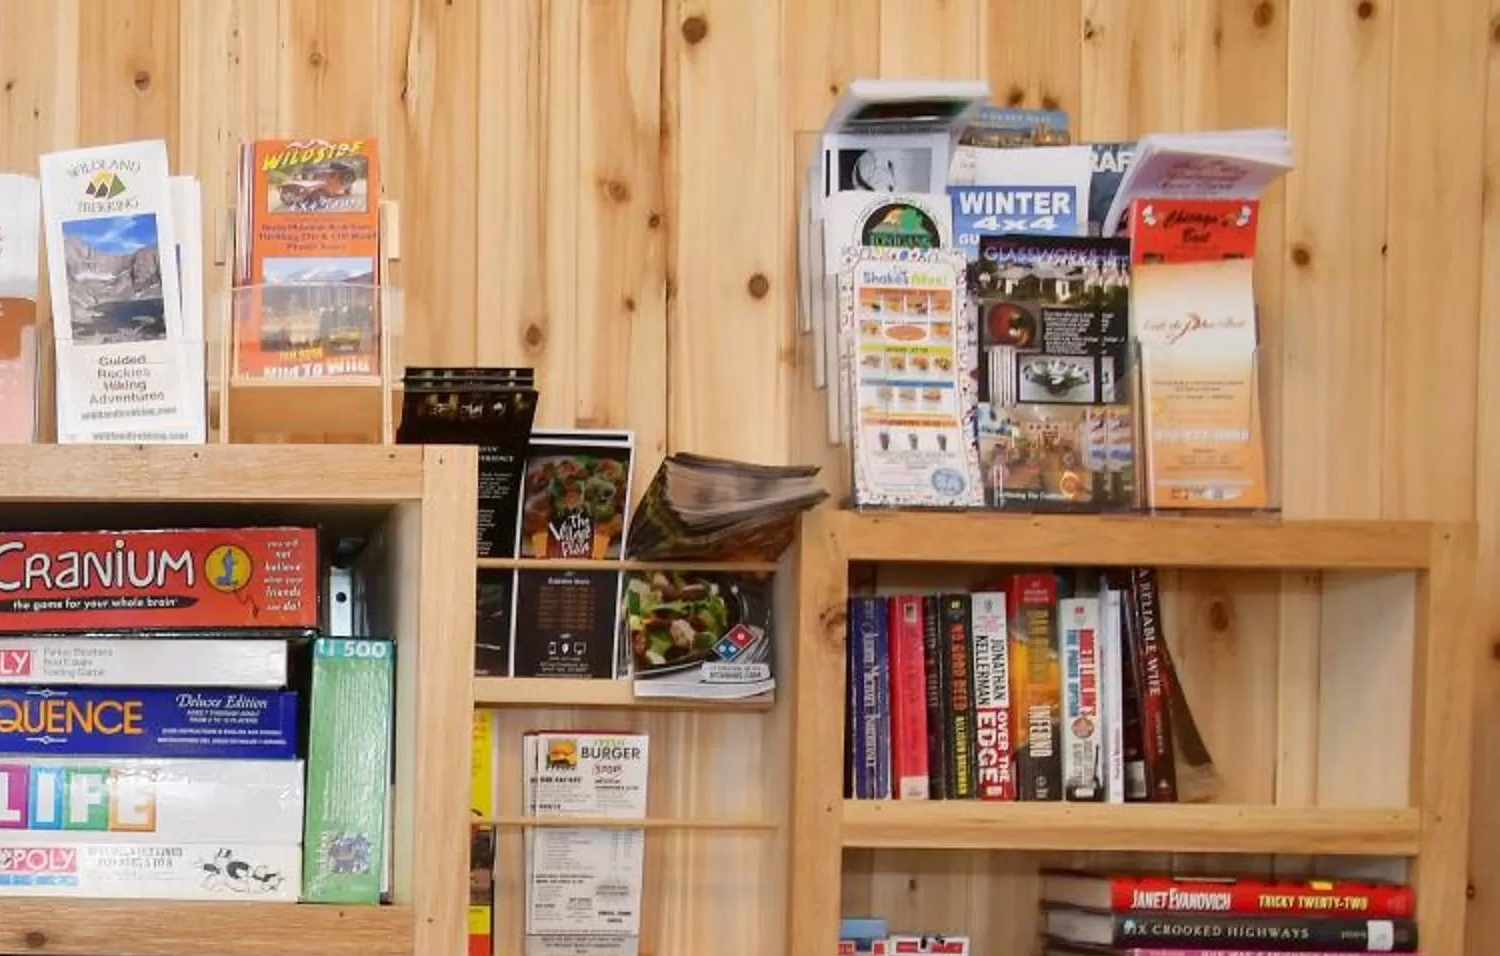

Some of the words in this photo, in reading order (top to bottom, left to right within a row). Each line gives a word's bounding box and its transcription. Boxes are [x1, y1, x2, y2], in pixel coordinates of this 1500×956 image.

[959, 192, 1071, 216] WINTER
[13, 600, 30, 610] the
[32, 601, 62, 612] game
[65, 598, 82, 609] for
[110, 598, 143, 609] whole
[145, 597, 177, 608] brain
[975, 635, 991, 706] KELLERMAN
[997, 711, 1009, 751] OVER
[581, 747, 640, 760] BURGER
[976, 711, 997, 785] EDGE
[999, 755, 1011, 783] THE
[1131, 890, 1168, 909] JANET
[1169, 889, 1232, 911] EVANOVICH
[1258, 894, 1295, 909] TRICKY
[1298, 896, 1369, 911] TWENTY-TWO
[1152, 924, 1222, 938] CROOKED
[1227, 926, 1309, 940] HIGHWAYS
